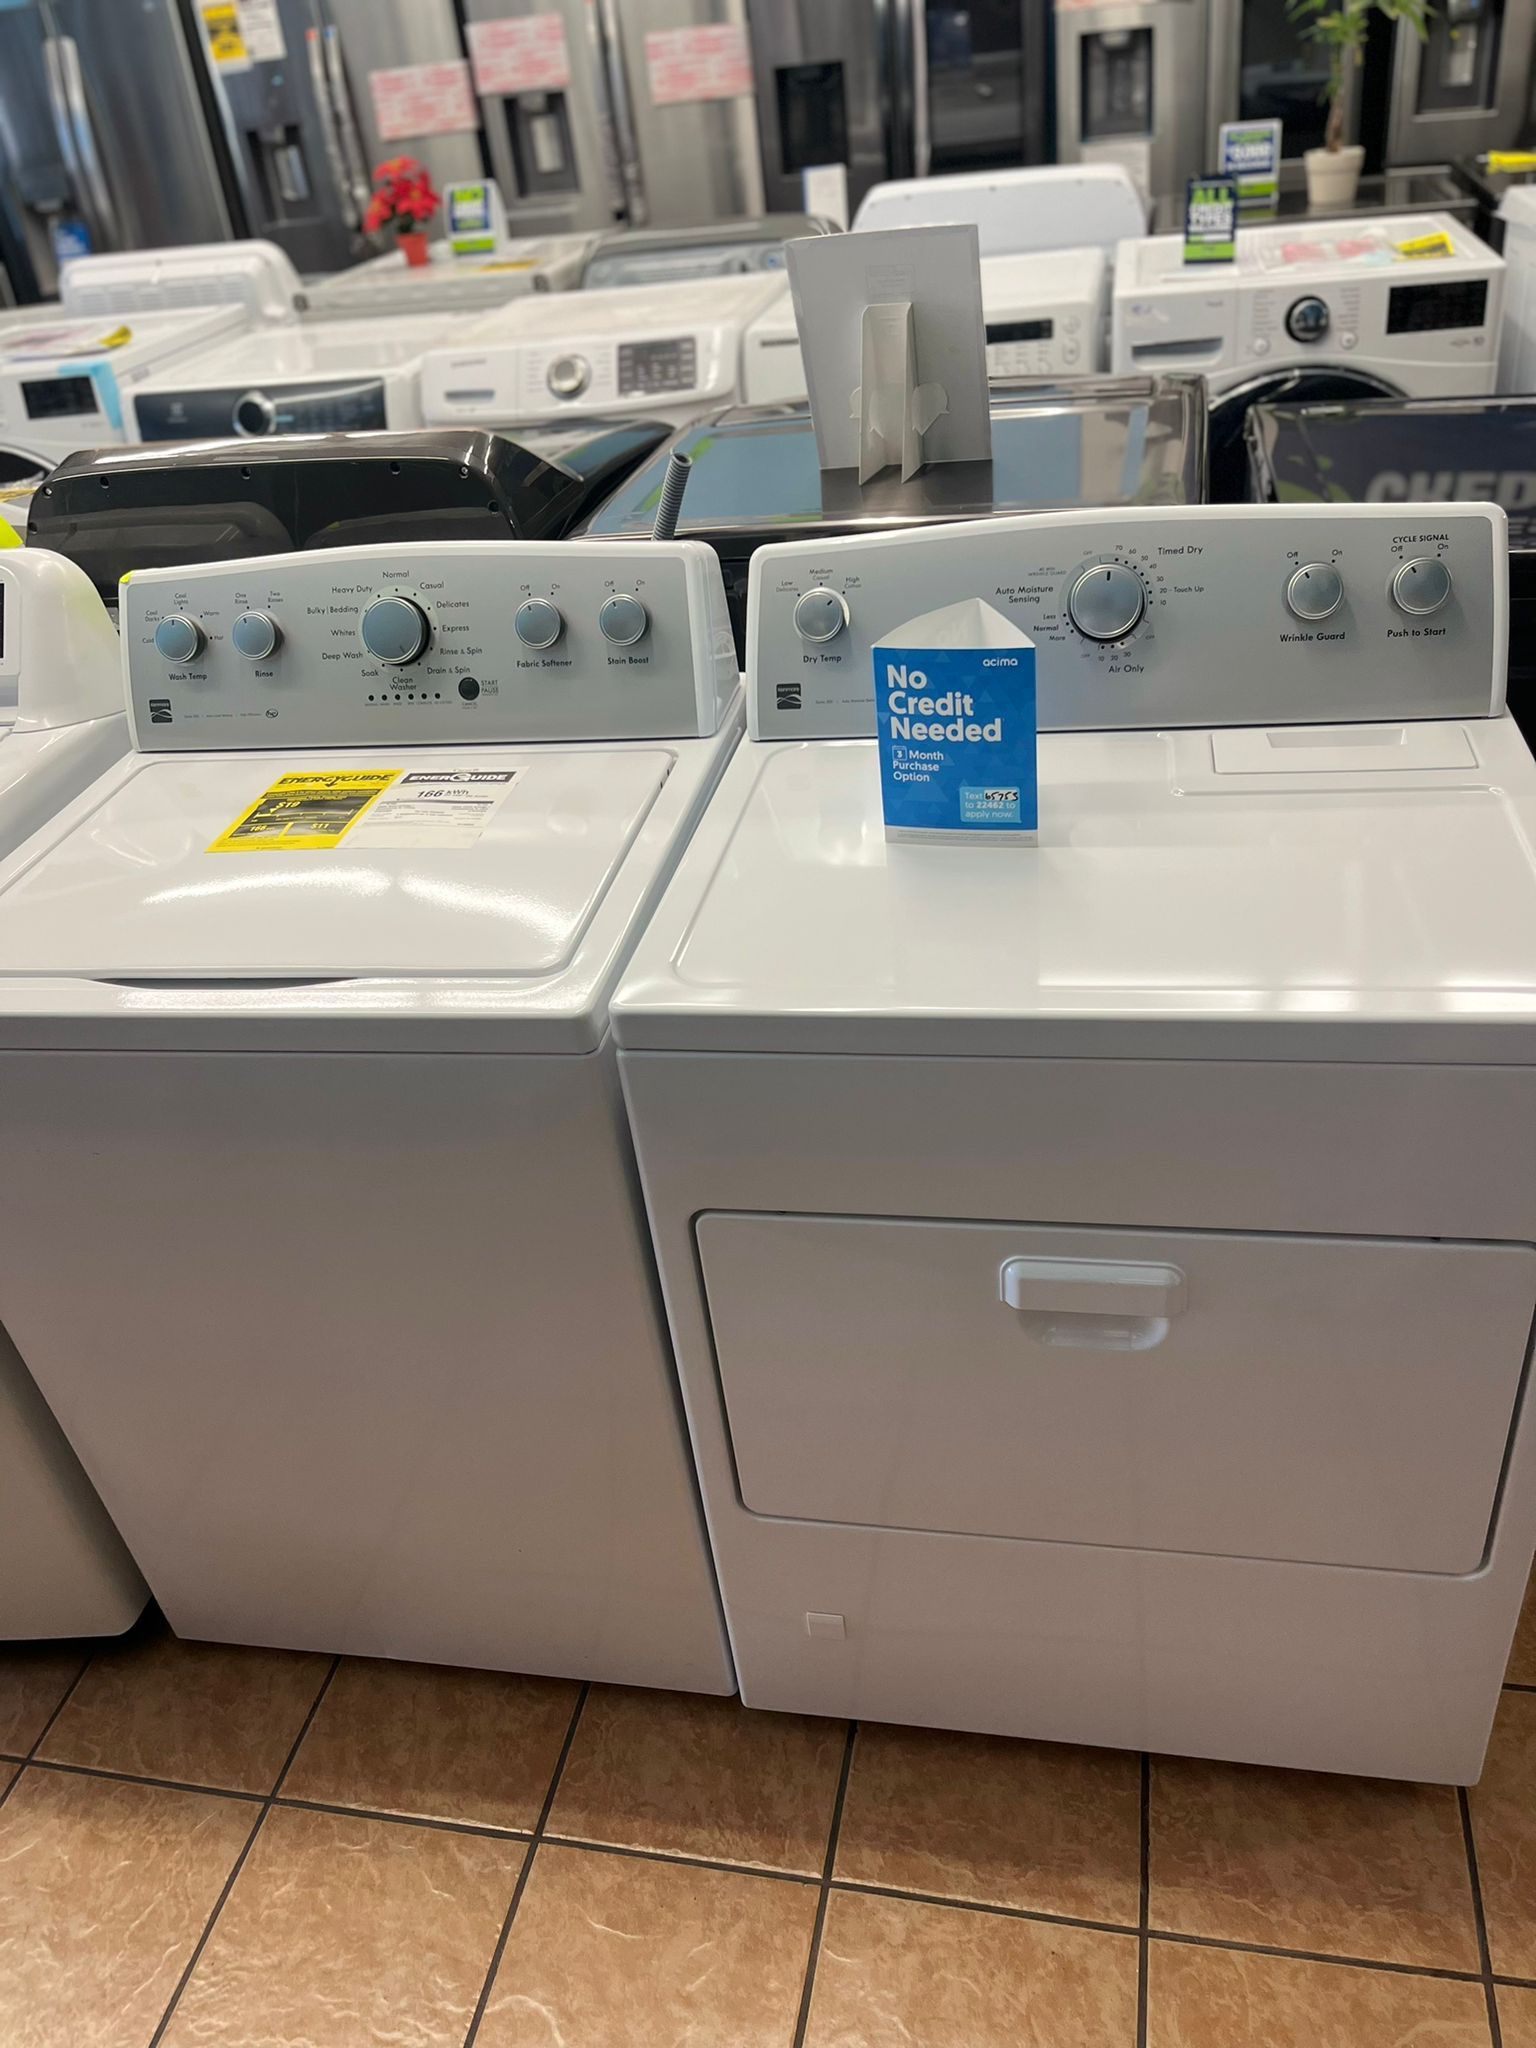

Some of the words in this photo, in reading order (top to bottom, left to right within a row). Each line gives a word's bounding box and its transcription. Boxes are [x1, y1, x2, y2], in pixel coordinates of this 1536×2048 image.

[1193, 186, 1233, 204] ALL
[1392, 535, 1418, 544] CYCLE
[1419, 534, 1449, 542] SIGNAL
[1158, 546, 1184, 555] Timed
[1187, 546, 1203, 555] Dry
[1390, 545, 1403, 553] Off
[1287, 551, 1299, 559] Off
[382, 570, 410, 579] Normal
[420, 581, 445, 590] Casual
[520, 584, 531, 592] Off
[551, 583, 561, 591] On
[605, 580, 615, 588] Off
[331, 585, 354, 595] Heavy
[356, 584, 373, 595] Duty
[995, 586, 1015, 595] Auto
[1018, 585, 1054, 594] Moisture
[1193, 585, 1204, 594] Up
[436, 600, 470, 609] Delicates
[1008, 595, 1041, 605] Sensing
[442, 624, 470, 634] Express
[1033, 624, 1059, 632] Normal
[1387, 629, 1409, 638] Push
[1411, 629, 1421, 637] to
[1424, 627, 1446, 637] Start
[331, 629, 356, 637] Whites
[1279, 633, 1313, 642] Wrinkle
[1317, 632, 1346, 641] Guard
[439, 647, 459, 656] Rinse
[466, 646, 483, 656] Spin
[322, 652, 341, 661] Deep
[342, 651, 364, 659] Wash
[607, 657, 626, 665] Stain
[628, 656, 649, 664] Boost
[803, 654, 818, 664] Dry
[820, 654, 842, 664] Temp
[516, 659, 539, 669] Fabric
[541, 659, 573, 668] Softener
[982, 657, 1019, 667] acima
[361, 669, 379, 677] Soak
[427, 667, 447, 675] Drain
[454, 666, 471, 675] Spin
[1108, 665, 1121, 673] Air
[1123, 664, 1145, 674] Only
[188, 672, 208, 681] Temp
[255, 670, 274, 678] Rinse
[886, 664, 928, 690] No
[392, 676, 414, 684] Clean
[389, 683, 417, 692] Washer
[888, 691, 975, 717] Credit
[890, 717, 1002, 743] Needed
[908, 750, 945, 761] Month
[892, 760, 940, 772] Purchase
[278, 774, 395, 788] ENERGYGUIDE
[893, 771, 931, 784] Option
[417, 790, 444, 798] 166
[965, 792, 983, 800] Text
[965, 810, 991, 819] apply
